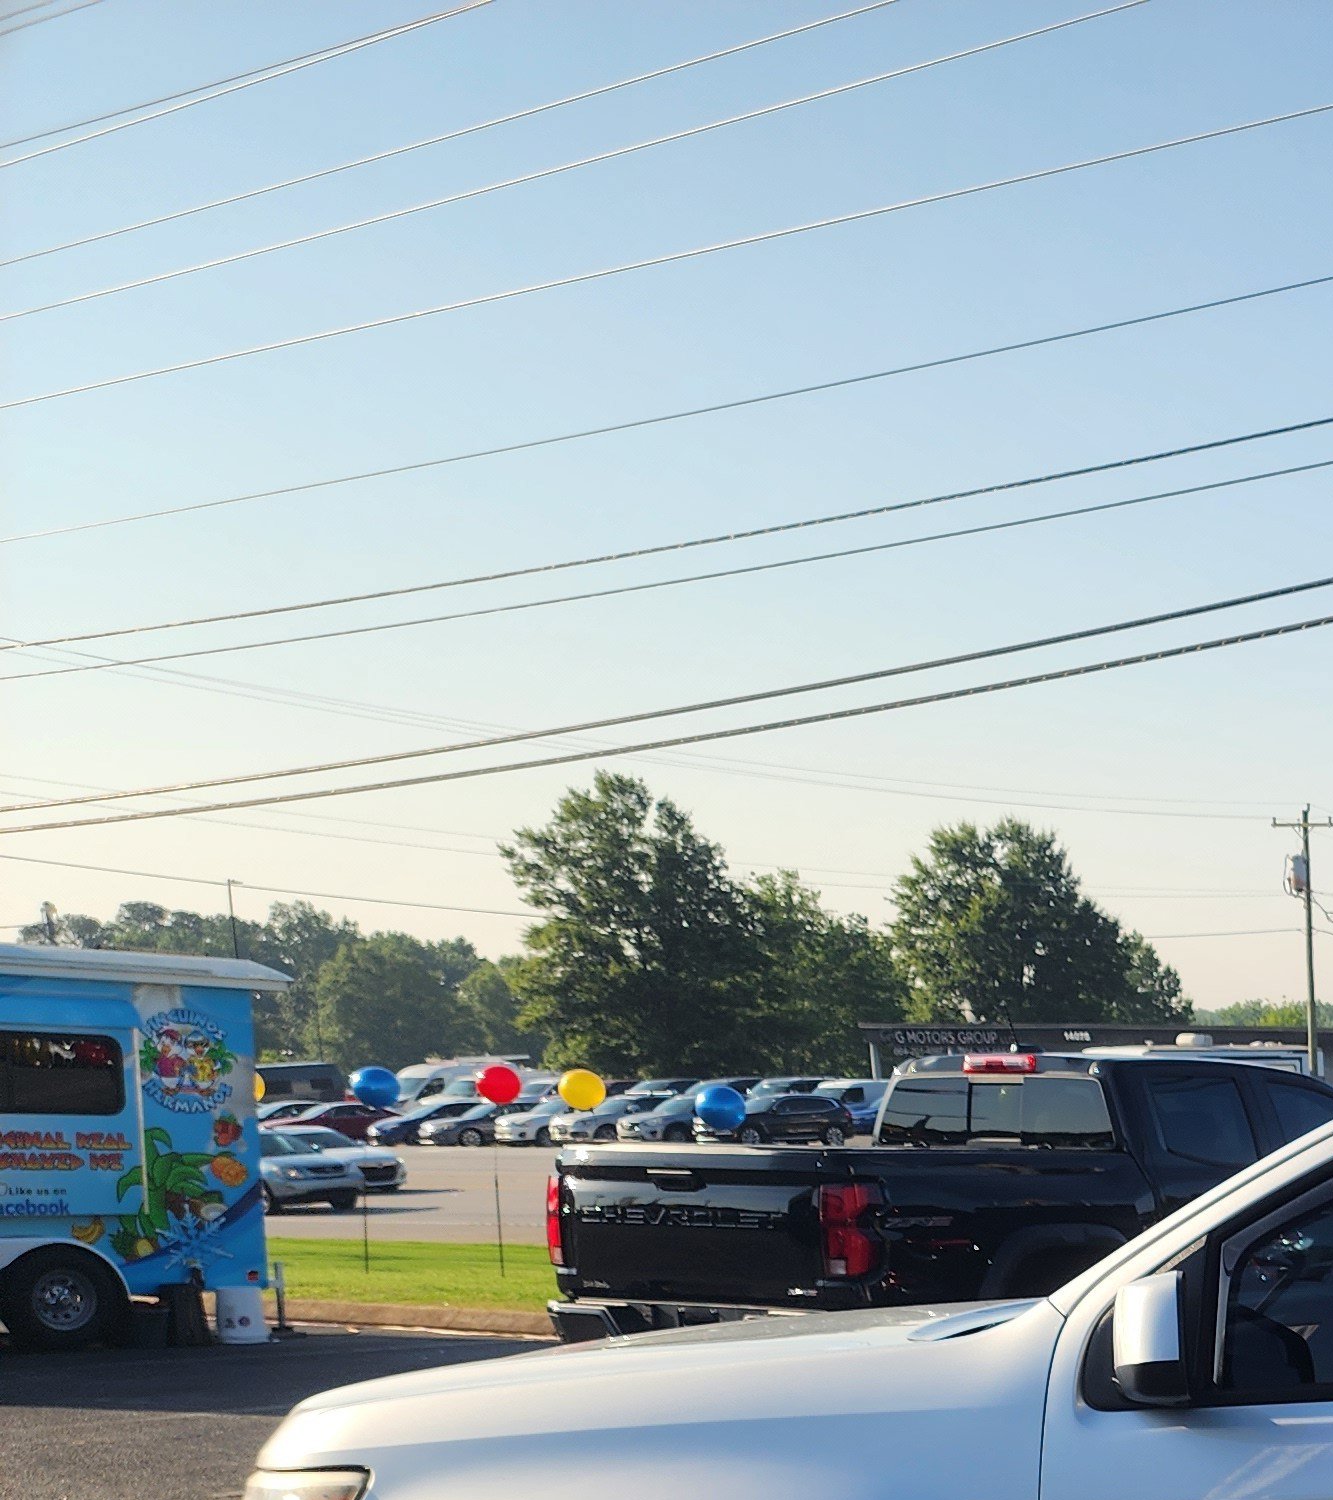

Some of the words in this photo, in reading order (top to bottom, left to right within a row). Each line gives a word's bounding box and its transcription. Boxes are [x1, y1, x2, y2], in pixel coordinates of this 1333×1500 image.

[906, 1031, 956, 1044] MOTORS
[957, 1031, 998, 1044] GROUP
[581, 1203, 783, 1230] CHEVROLET
